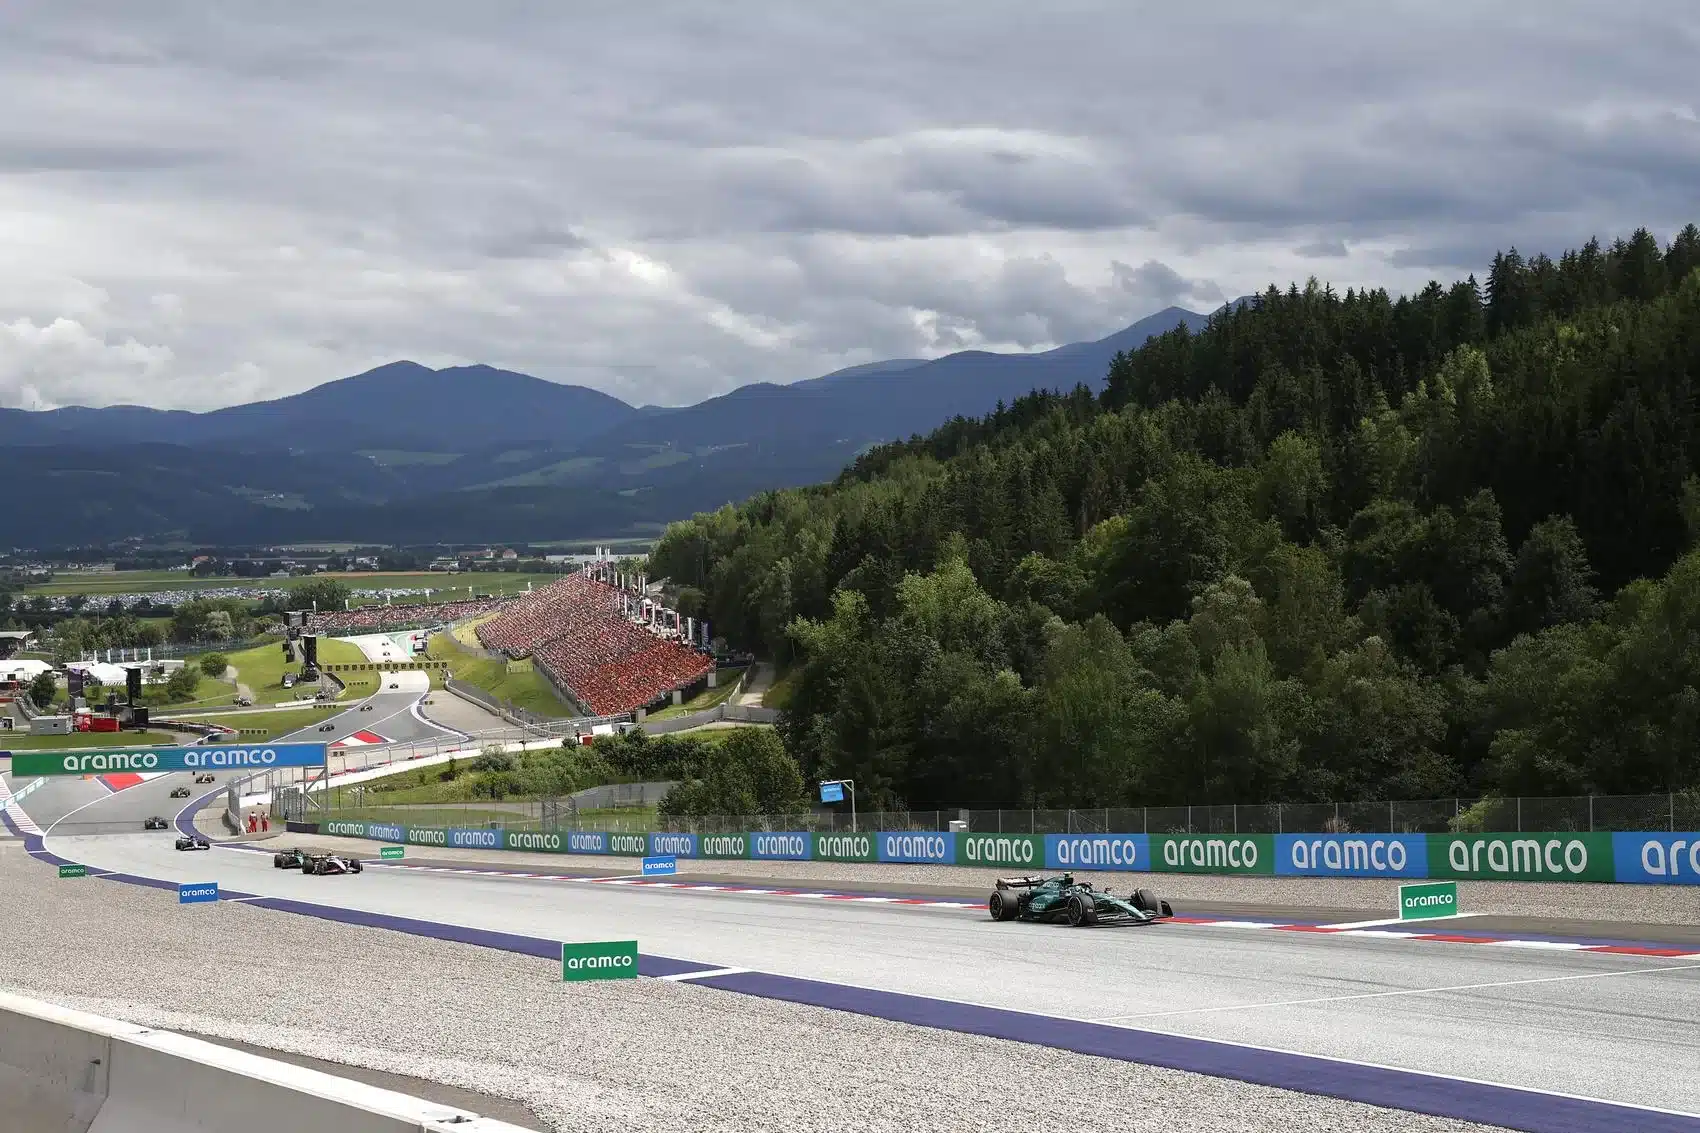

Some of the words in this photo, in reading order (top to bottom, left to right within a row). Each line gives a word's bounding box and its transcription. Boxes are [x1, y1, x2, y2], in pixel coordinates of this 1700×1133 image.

[64, 752, 158, 771] aramco
[184, 748, 276, 766] aramco
[328, 822, 364, 836] aramco
[369, 825, 400, 840] aramco
[409, 827, 445, 844] aramco
[454, 830, 495, 847] aramco
[509, 832, 561, 849] aramco
[572, 834, 601, 851] aramco
[612, 836, 645, 853] aramco
[655, 836, 691, 855] aramco
[704, 836, 744, 856] aramco
[757, 836, 804, 856] aramco
[818, 836, 869, 857] aramco
[886, 836, 945, 858] aramco
[382, 848, 404, 857] aramco
[966, 837, 1033, 863] aramco
[1057, 839, 1136, 865] aramco
[1164, 839, 1257, 868] aramco
[1292, 840, 1407, 871] aramco
[1449, 839, 1587, 874] aramco
[60, 866, 85, 876] aramco
[645, 861, 674, 870] aramco
[181, 889, 216, 897] aramco
[1405, 893, 1453, 909] aramco
[568, 955, 632, 969] aramco
